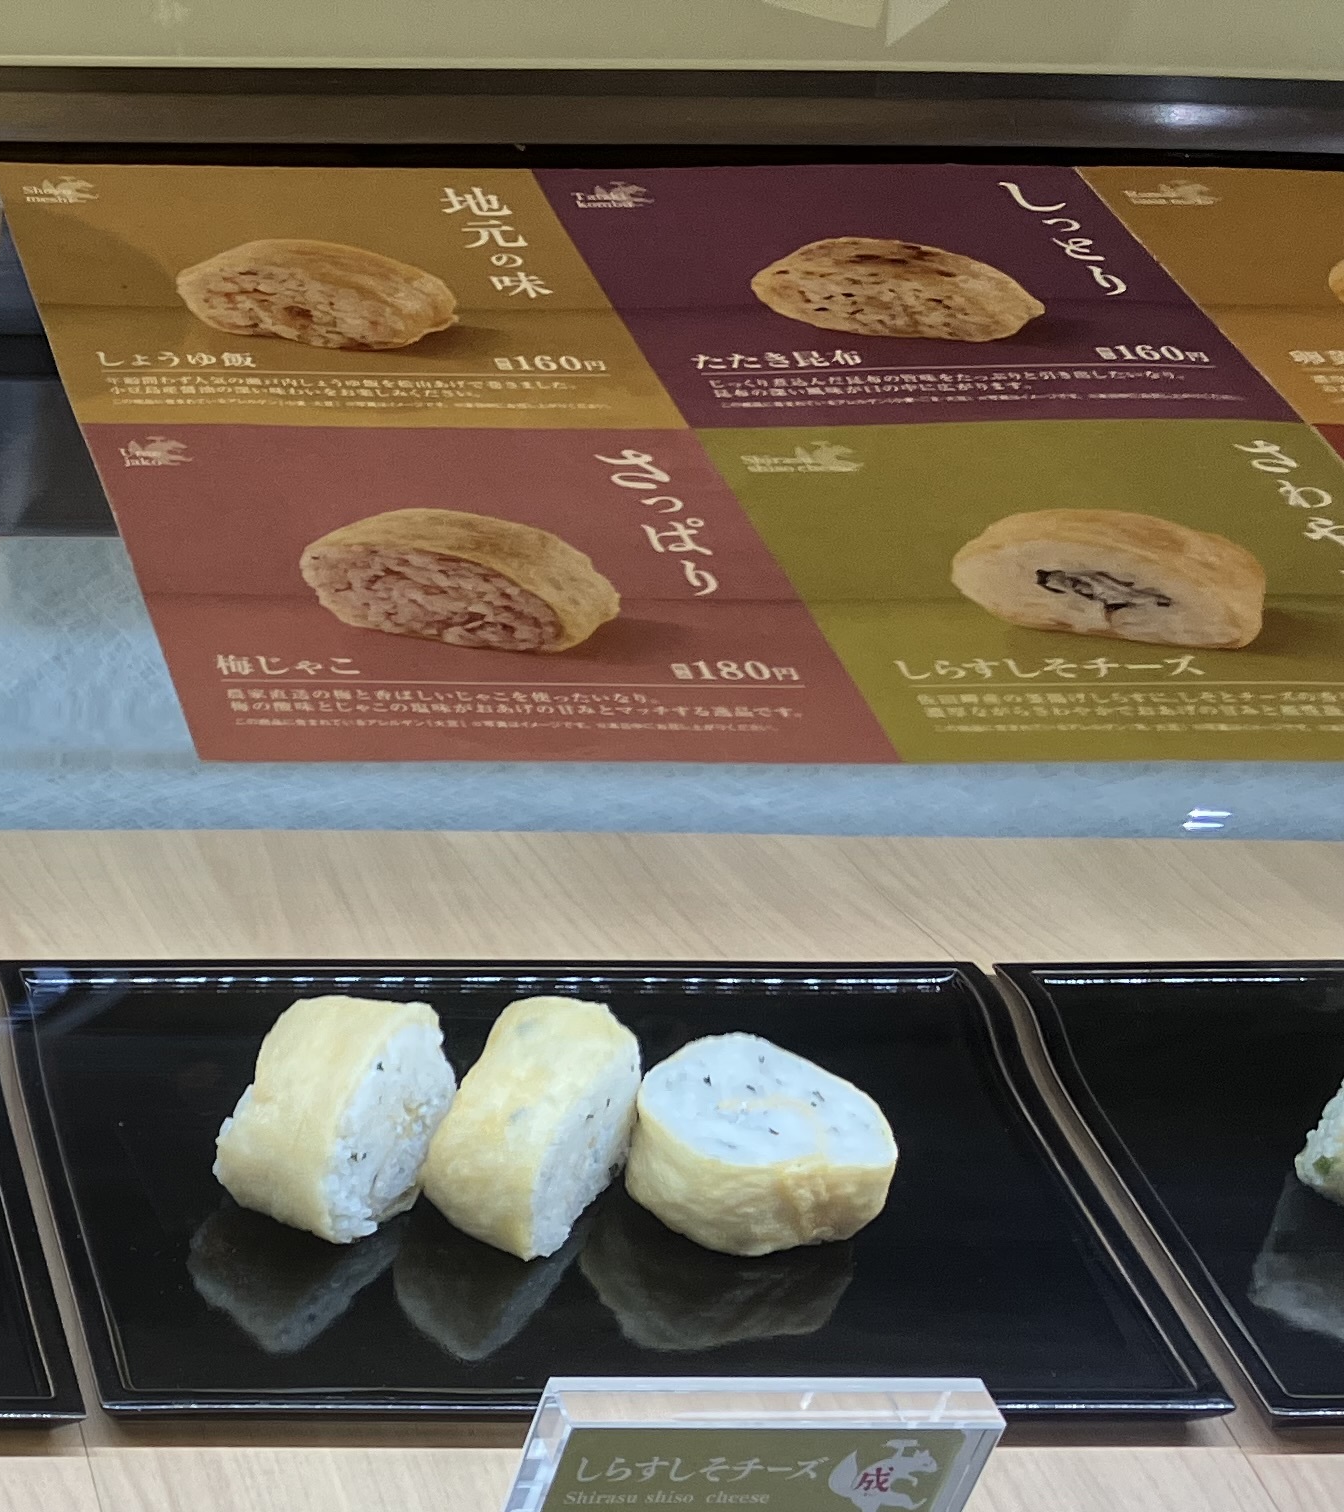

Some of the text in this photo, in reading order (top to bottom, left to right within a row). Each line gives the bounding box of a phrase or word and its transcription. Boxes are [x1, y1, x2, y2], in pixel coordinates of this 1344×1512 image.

[440, 187, 553, 299] 地元の味
[998, 181, 1127, 296] しっとり
[97, 351, 256, 367] しょうゆ飯
[691, 350, 863, 369] たたき昆布
[593, 449, 719, 597] さっぱり
[217, 654, 361, 675] 梅じゃこ
[576, 1456, 830, 1483] しらすしそチーズ
[854, 1466, 894, 1492] 成
[563, 1489, 771, 1505] Shirasu shiso cheese
